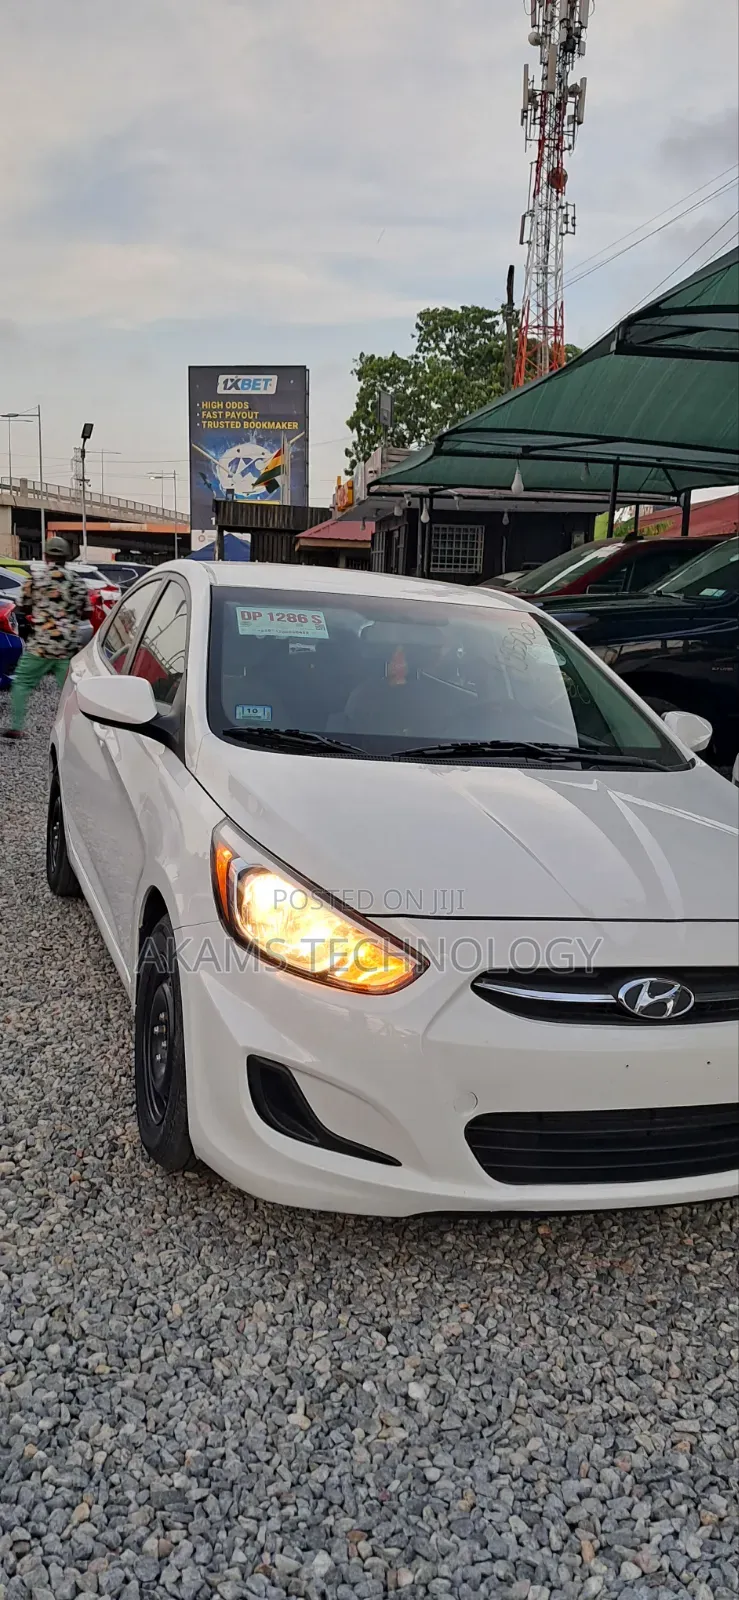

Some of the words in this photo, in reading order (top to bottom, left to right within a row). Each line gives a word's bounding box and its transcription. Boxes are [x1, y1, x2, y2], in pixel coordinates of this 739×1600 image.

[201, 401, 223, 410] HIGH
[225, 401, 250, 410] ODDS
[201, 411, 223, 419] FAST
[225, 411, 260, 420] PAYOUT
[201, 420, 241, 429] TRUSTED
[243, 421, 299, 430] BOOKMAKER
[240, 610, 263, 621] DP
[267, 611, 308, 624] 1286
